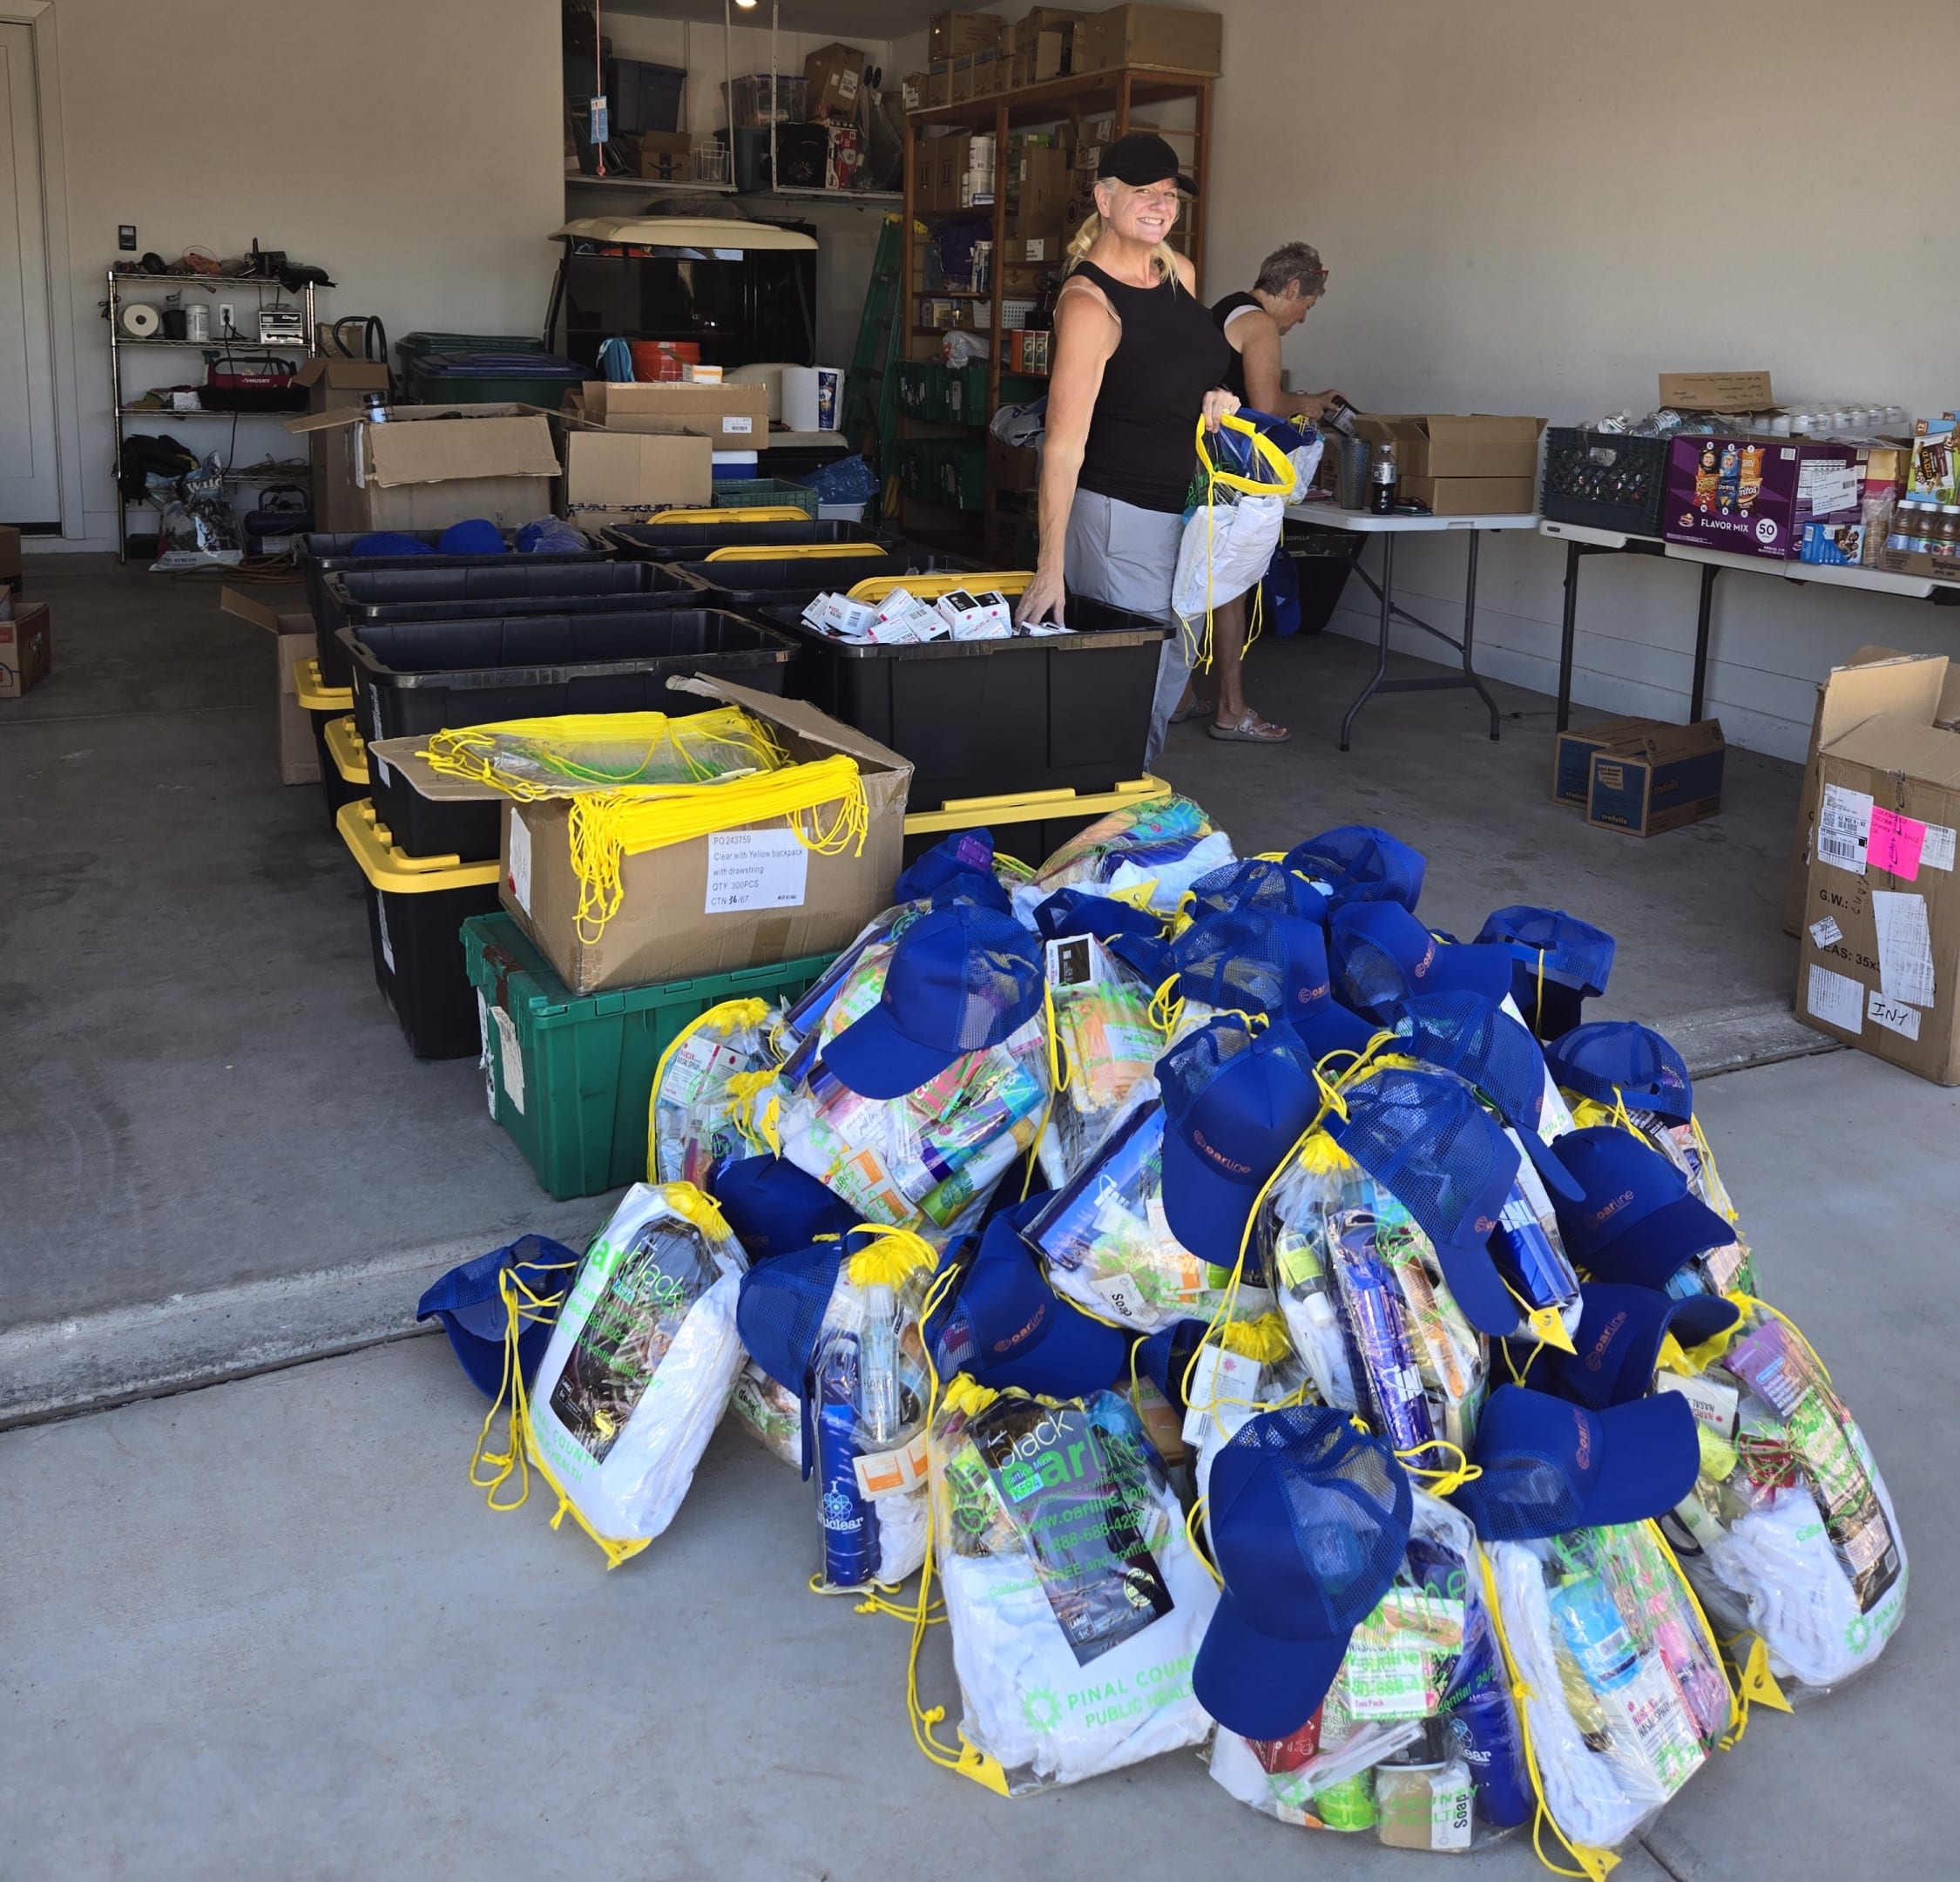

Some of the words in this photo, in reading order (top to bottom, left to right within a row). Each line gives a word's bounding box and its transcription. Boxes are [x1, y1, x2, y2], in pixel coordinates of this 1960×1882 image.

[1917, 423, 1925, 431] 12
[186, 476, 222, 494] Wild
[1701, 518, 1731, 531] FLAVOR
[1733, 523, 1749, 532] MIX
[1759, 524, 1774, 535] 50
[1601, 814, 1628, 825] trefoils
[713, 836, 725, 845] PO
[726, 835, 752, 845] 243759
[713, 852, 733, 861] Clear
[733, 850, 747, 859] with
[749, 850, 771, 858] Yellow
[772, 848, 803, 857] backpack
[713, 868, 727, 877] with
[728, 865, 764, 876] drawstring
[731, 880, 760, 890] 300PCS
[1205, 1144, 1252, 1174] oarline
[1598, 1189, 1634, 1221] oarline
[625, 1241, 685, 1301] black
[1112, 1293, 1132, 1317] Soap
[1010, 1303, 1046, 1344] oarline
[1596, 1310, 1627, 1352] oarline
[552, 1430, 601, 1472] COUNTY
[991, 1410, 1074, 1472] black
[831, 1480, 839, 1493] I
[1012, 1476, 1043, 1500] KF94
[1066, 1678, 1129, 1710] PINAL
[1369, 1699, 1384, 1708] Pack
[1085, 1701, 1144, 1729] PUBLIC
[1454, 1793, 1470, 1829] Soap
